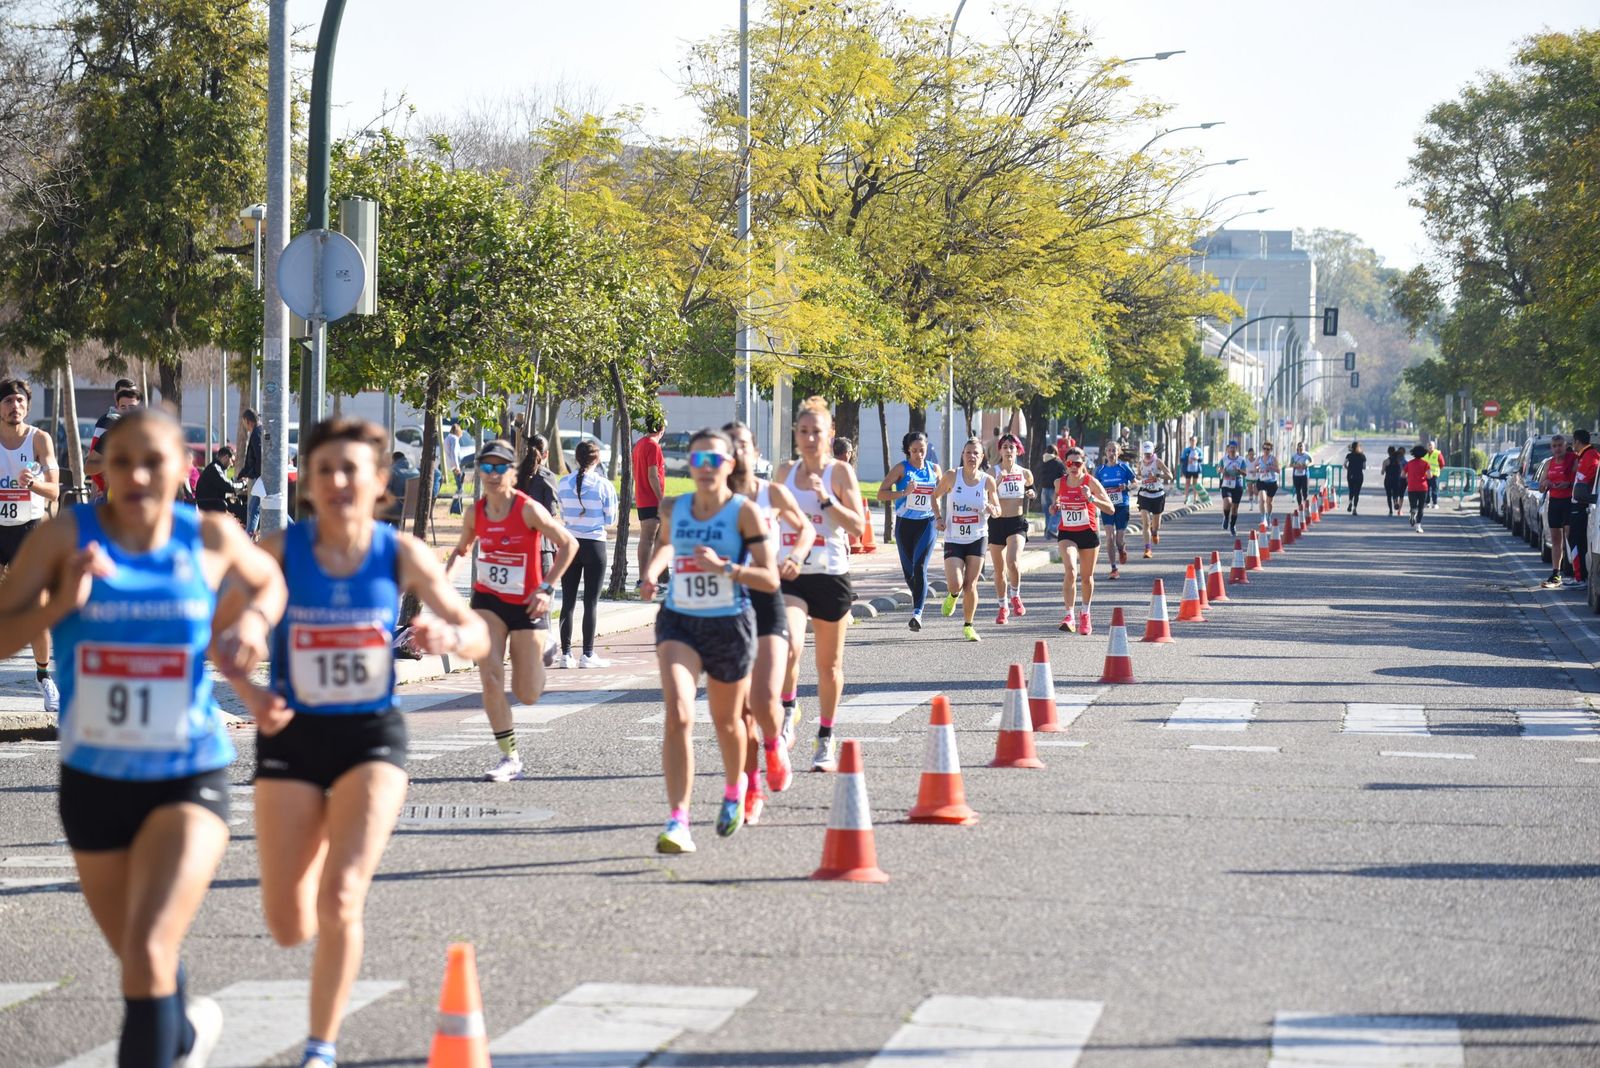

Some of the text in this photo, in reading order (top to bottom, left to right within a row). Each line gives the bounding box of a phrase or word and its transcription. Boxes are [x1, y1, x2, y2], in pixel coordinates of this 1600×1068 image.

[914, 495, 926, 506] 20
[1066, 511, 1082, 522] 207
[675, 526, 723, 543] nerja
[960, 525, 971, 536] 94
[489, 566, 508, 585] 83
[685, 575, 719, 598] 195
[315, 654, 369, 687] 156
[106, 684, 152, 726] 91
